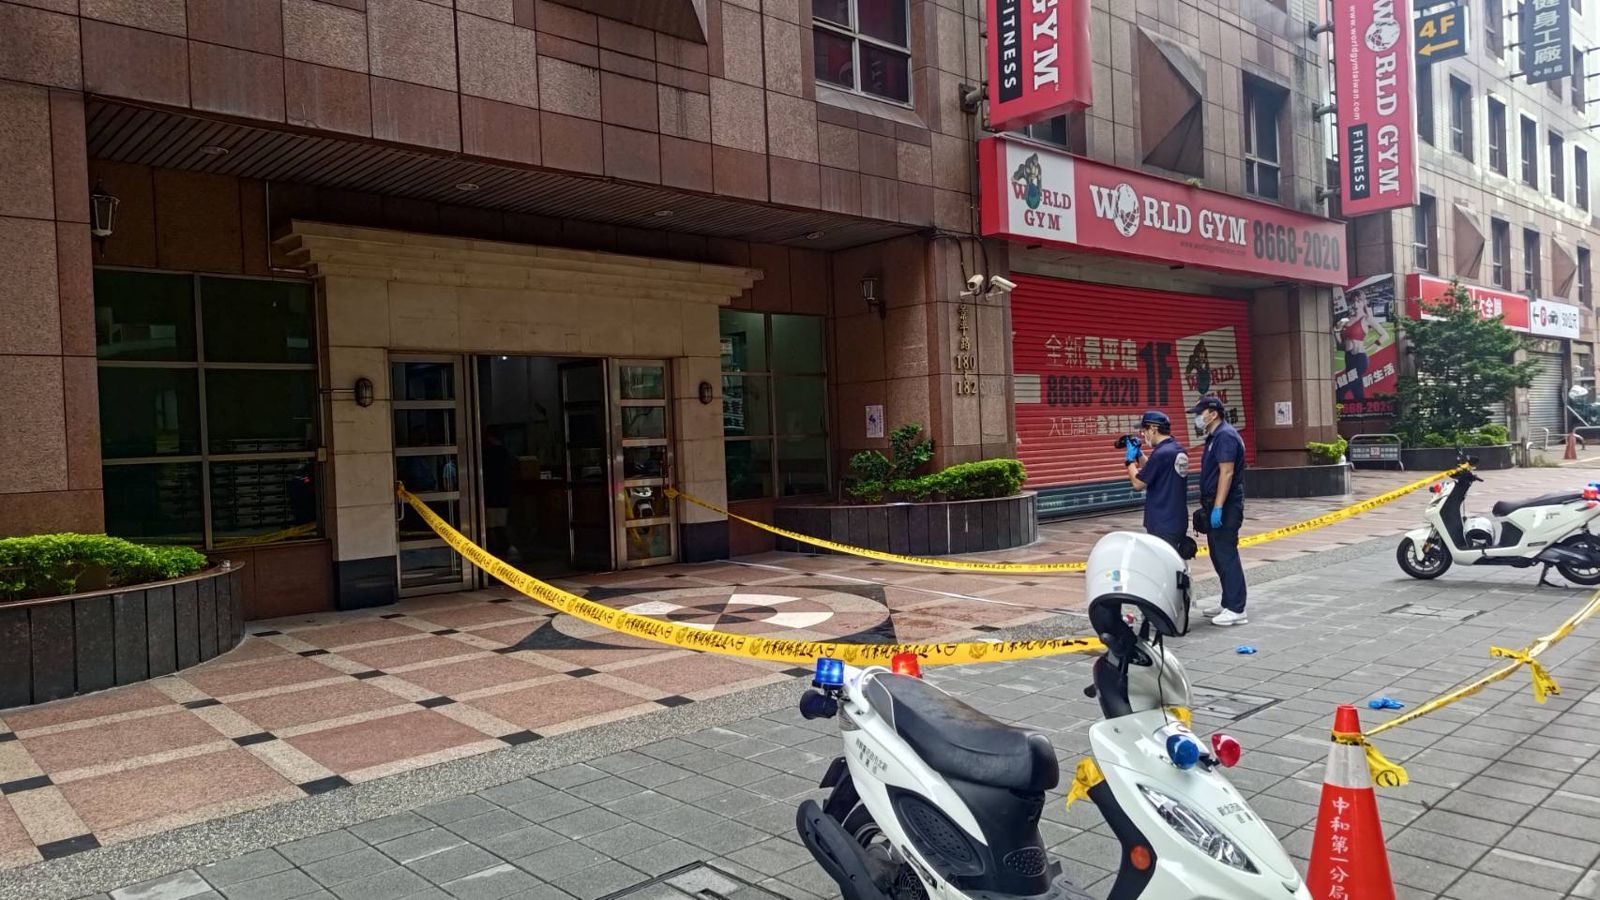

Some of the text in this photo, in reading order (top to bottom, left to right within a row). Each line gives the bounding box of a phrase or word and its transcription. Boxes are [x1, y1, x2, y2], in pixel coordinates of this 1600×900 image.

[1003, 0, 1016, 89] ITNESS
[1419, 14, 1456, 38] 4F
[1349, 5, 1361, 120] www.worldgymtaiwan.com
[1353, 130, 1365, 191] FITNESS
[1377, 125, 1400, 194] GYM
[1024, 209, 1061, 231] GYM
[1199, 209, 1249, 246] GYM
[1253, 220, 1341, 272] 8668-2020
[955, 355, 976, 370] 180
[957, 381, 977, 395] 182
[1045, 334, 1173, 406] 全新景平店 1F
[1046, 374, 1139, 407] 8668-2020
[1329, 796, 1350, 900] 中和第一分局
